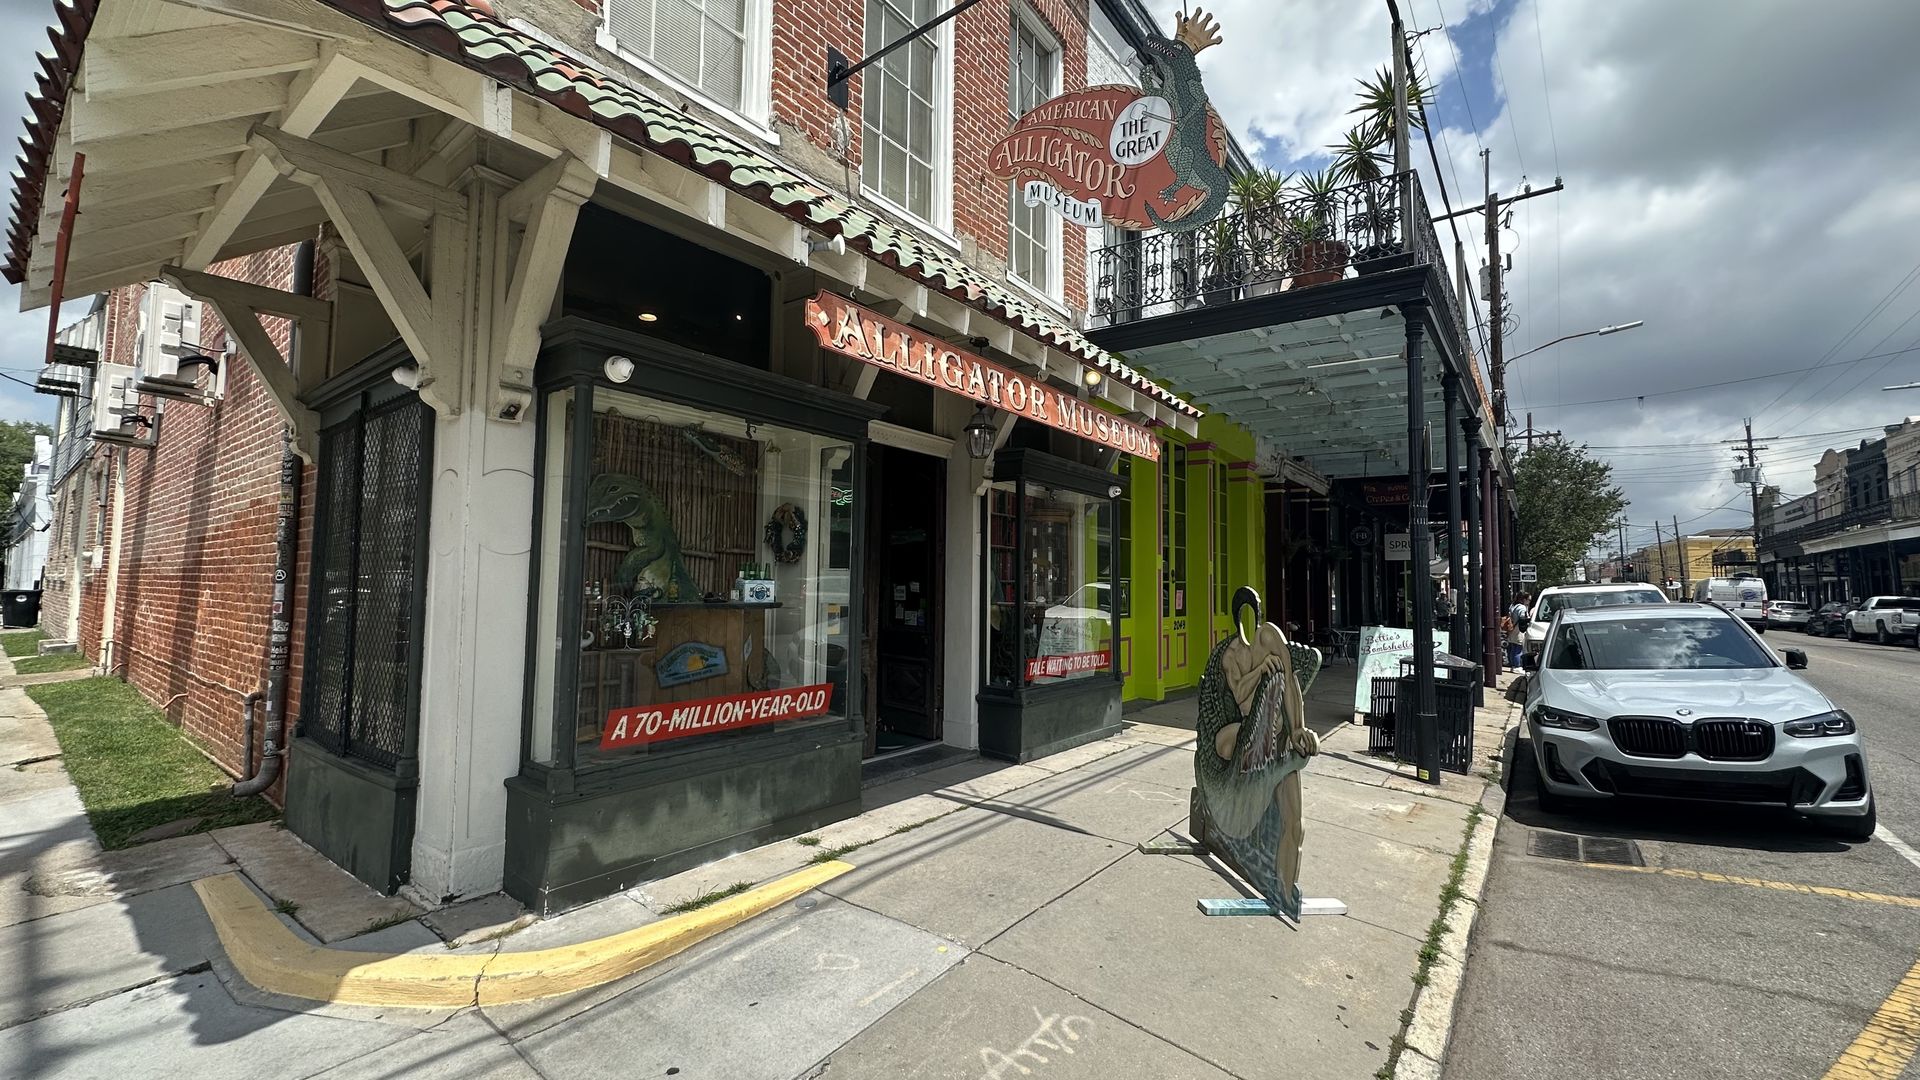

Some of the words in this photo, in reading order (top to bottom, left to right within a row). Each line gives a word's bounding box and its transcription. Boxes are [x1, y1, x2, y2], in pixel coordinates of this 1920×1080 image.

[1028, 99, 1118, 126] AMERICAN
[1119, 117, 1149, 138] THE
[1115, 130, 1162, 159] GREAT
[995, 134, 1137, 199] ALLIGATOR
[1029, 184, 1098, 223] MUSEUM
[831, 303, 1049, 420] ALLIGATOR
[1056, 392, 1153, 458] MUSEUM
[1360, 640, 1414, 655] Bombshells
[1365, 631, 1401, 645] Bettie's
[1029, 660, 1046, 677] TALE
[1046, 657, 1073, 673] WAITING
[1073, 657, 1081, 670] TO
[1082, 655, 1090, 668] BE
[610, 714, 628, 741] A
[633, 690, 826, 738] 70-MILLION-YEAR-OLD
